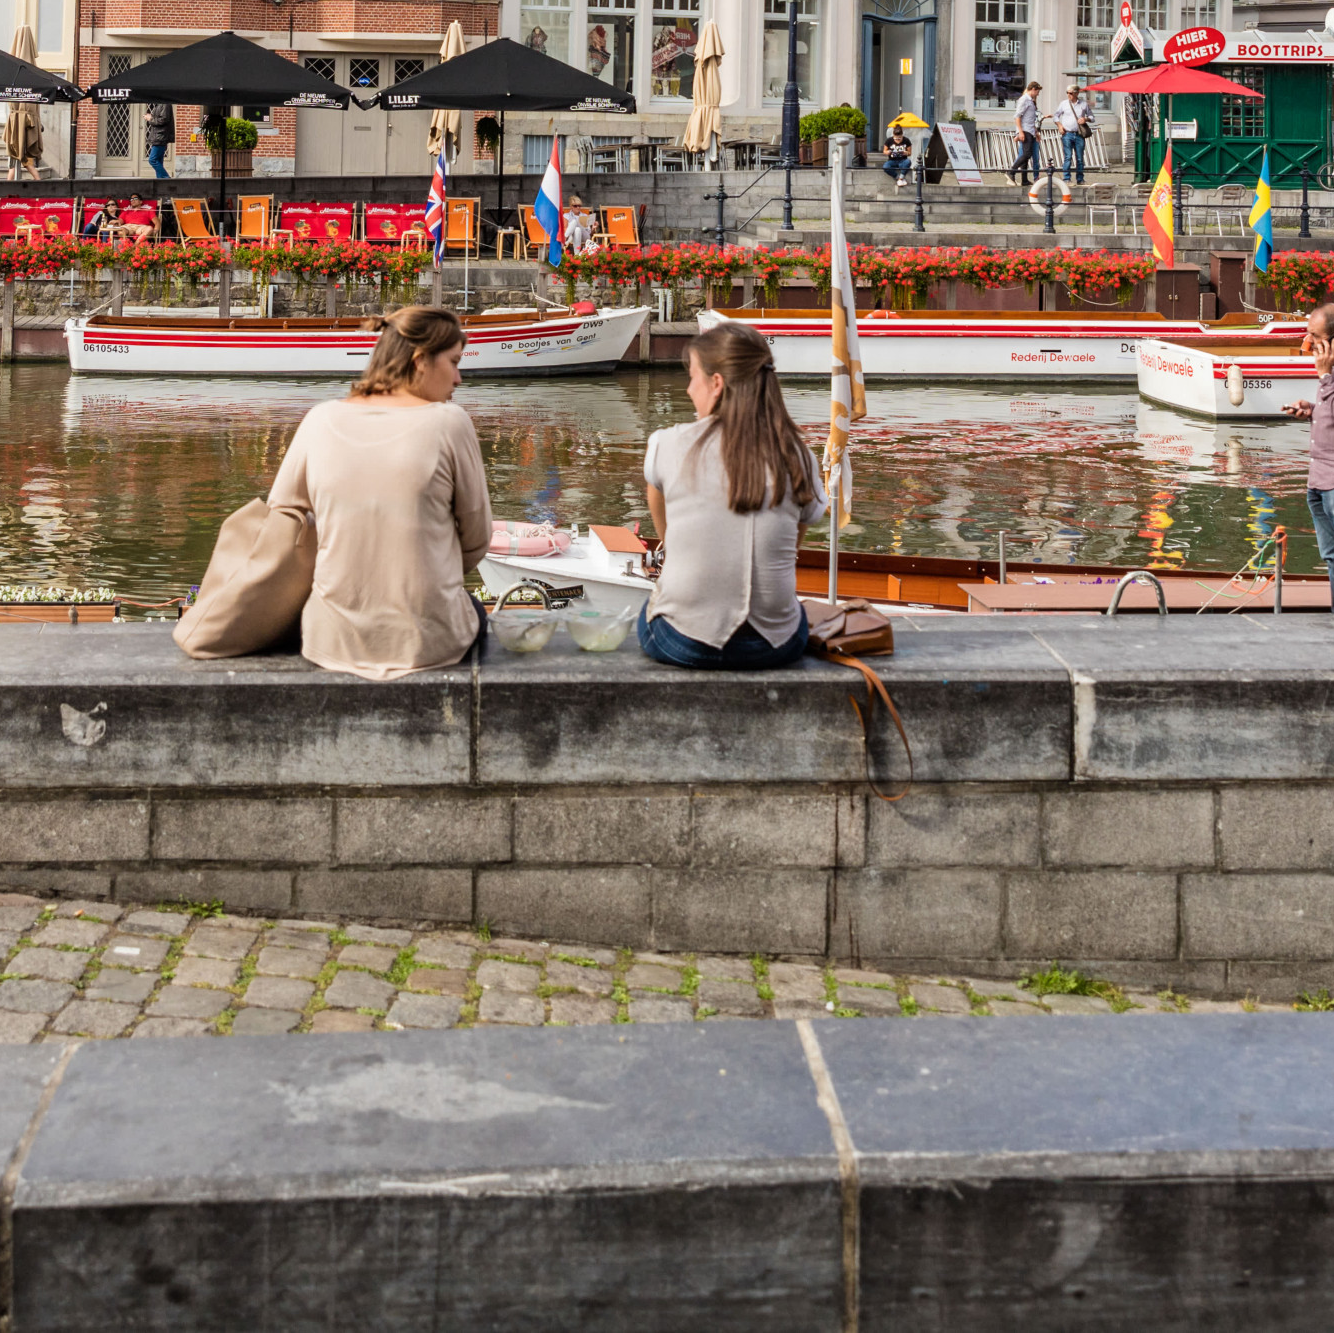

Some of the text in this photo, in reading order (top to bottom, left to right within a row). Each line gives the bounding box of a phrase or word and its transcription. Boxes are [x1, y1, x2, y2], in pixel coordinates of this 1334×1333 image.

[1176, 29, 1208, 47] HIER
[1170, 42, 1221, 64] TICKETS
[1237, 44, 1323, 57] BOOTTRIPS
[97, 88, 132, 97] LILLET
[388, 95, 421, 104] LILLET
[1258, 314, 1274, 322] 50P
[583, 320, 604, 329] DW9
[83, 343, 130, 354] 06105433
[500, 342, 513, 350] De
[518, 338, 550, 354] bootjes
[576, 333, 596, 342] Gent
[1011, 352, 1096, 363] Rederij Dewaele
[1157, 355, 1194, 377] Dewaele
